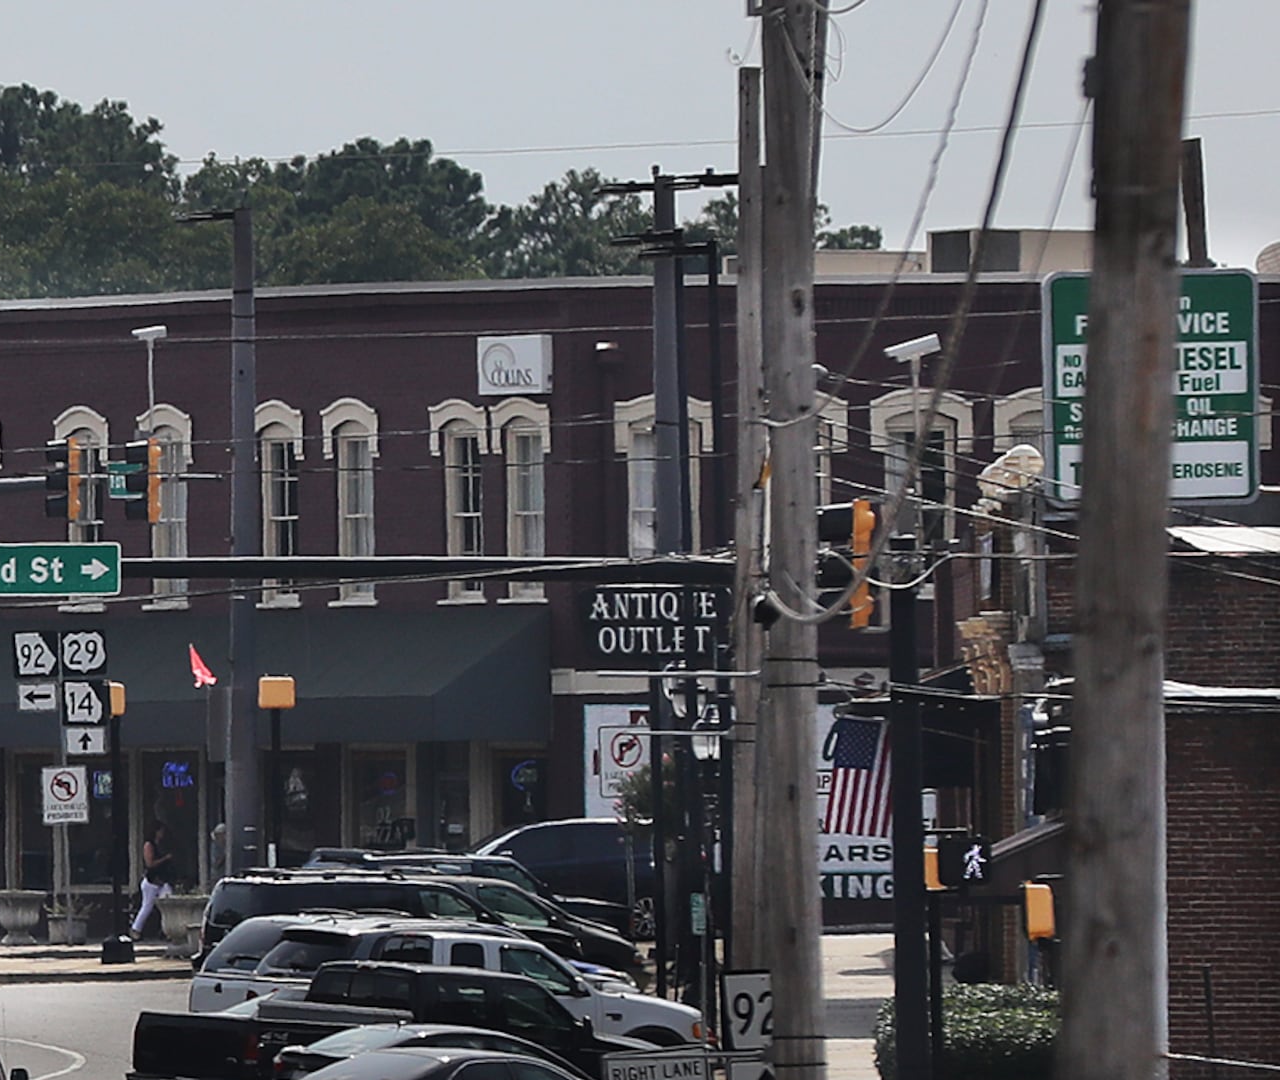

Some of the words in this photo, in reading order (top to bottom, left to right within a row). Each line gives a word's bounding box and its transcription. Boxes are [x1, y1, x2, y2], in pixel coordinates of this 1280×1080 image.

[1176, 312, 1230, 334] VICE
[1179, 373, 1221, 391] Fuel
[1186, 398, 1216, 416] OIL
[1172, 462, 1243, 479] EROSENE
[29, 555, 65, 583] St
[598, 626, 711, 654] OUTLET
[20, 643, 46, 668] 92
[68, 639, 98, 665] 29
[69, 690, 95, 716] 14
[733, 991, 774, 1037] 92
[663, 1060, 703, 1079] LANE
